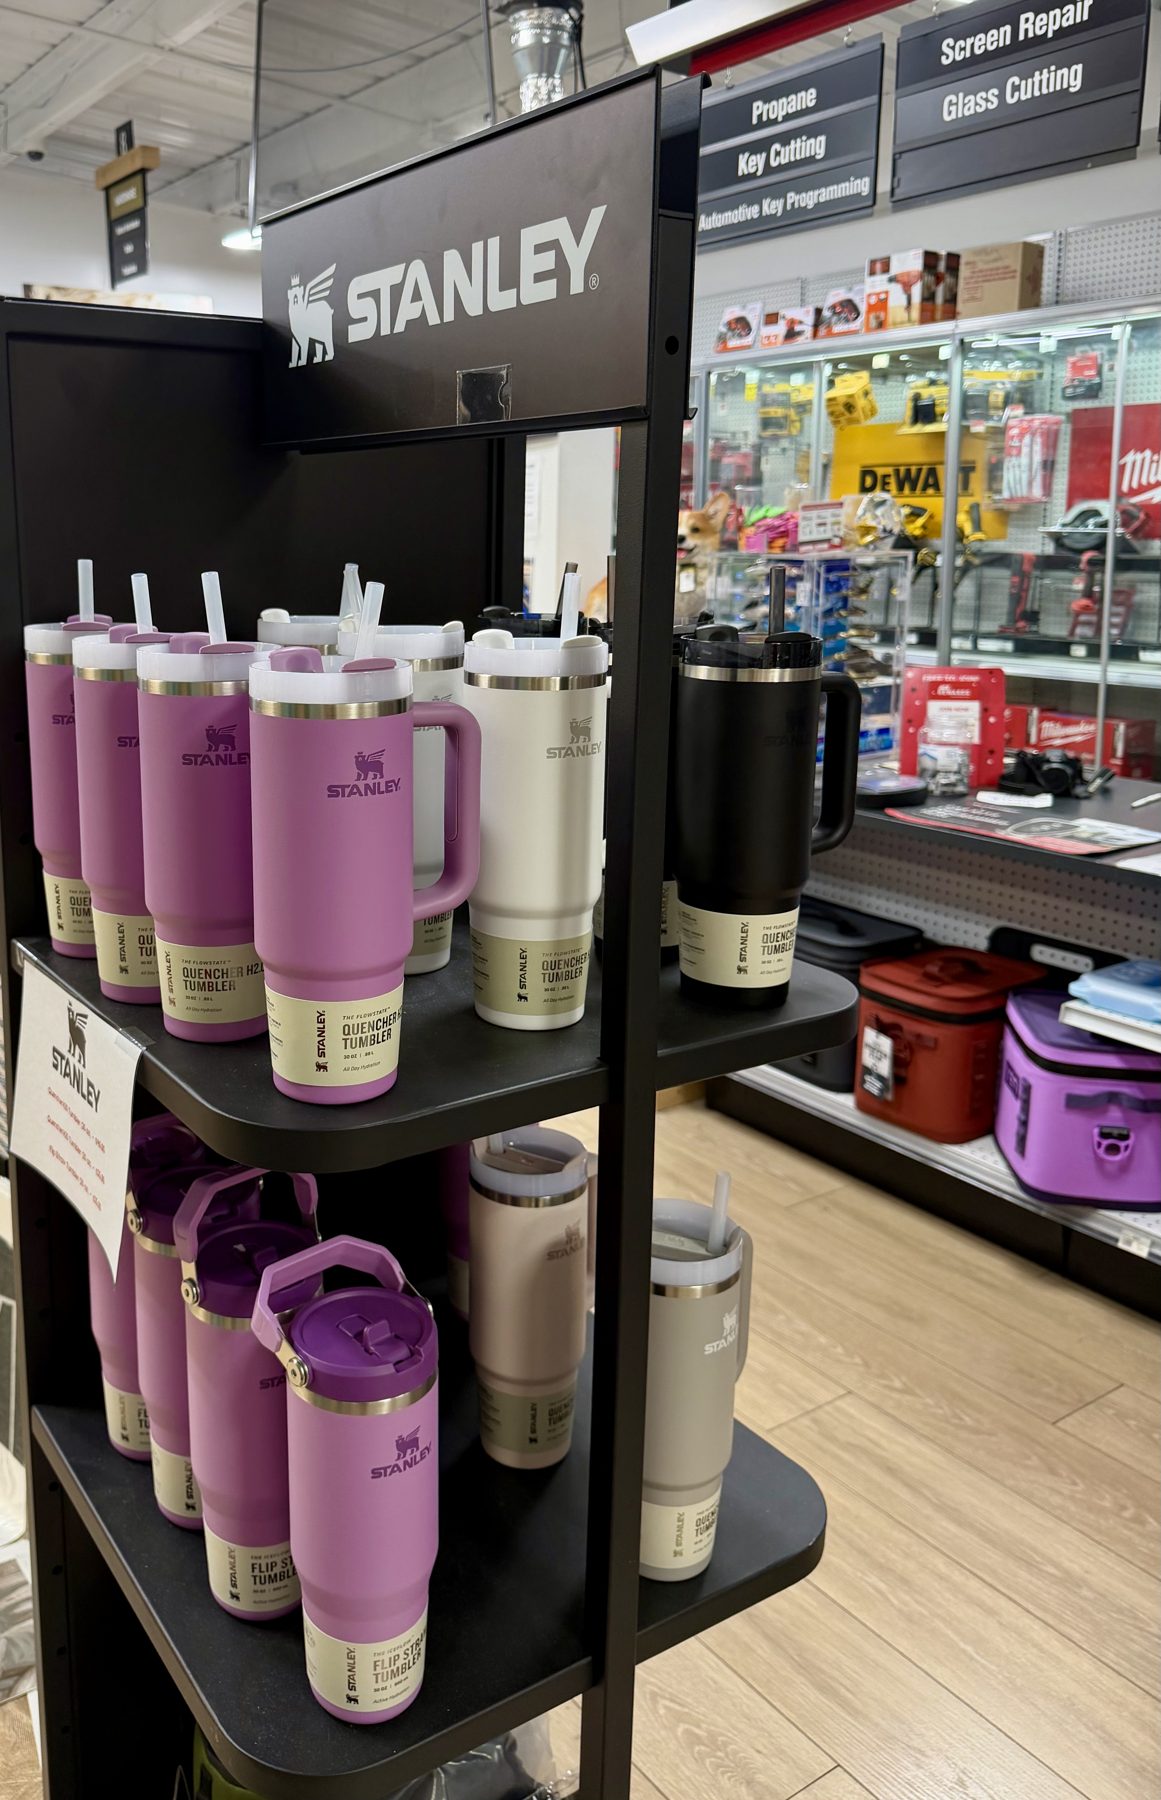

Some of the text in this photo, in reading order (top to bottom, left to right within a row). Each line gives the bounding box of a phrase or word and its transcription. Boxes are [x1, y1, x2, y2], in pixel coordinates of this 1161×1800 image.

[941, 0, 1093, 65] Screen Repair
[752, 88, 817, 125] Propane
[942, 63, 1083, 122] Glass Cutting
[737, 135, 826, 176] Key Cutting
[698, 176, 870, 232] Automotive Key Programming
[546, 741, 602, 760] STANLEY
[327, 777, 400, 798] STANLEY
[117, 922, 126, 962] STANLEY
[739, 922, 748, 963] STANLEY
[165, 950, 174, 994] STANLEY
[182, 967, 243, 980] QUENCHER
[183, 979, 236, 992] TUMBLER
[541, 966, 583, 984] TUMBLER
[317, 1010, 326, 1058] STANLEY
[342, 1028, 392, 1050] TUMBLER
[343, 1011, 397, 1036] QUENCHER
[52, 1045, 101, 1113] STANLEY
[371, 1441, 432, 1479] STANLEY
[251, 1561, 277, 1573] FLIP
[347, 1647, 356, 1691] STANLEY
[373, 1654, 400, 1671] FLIP
[373, 1647, 421, 1684] TUMBLER
